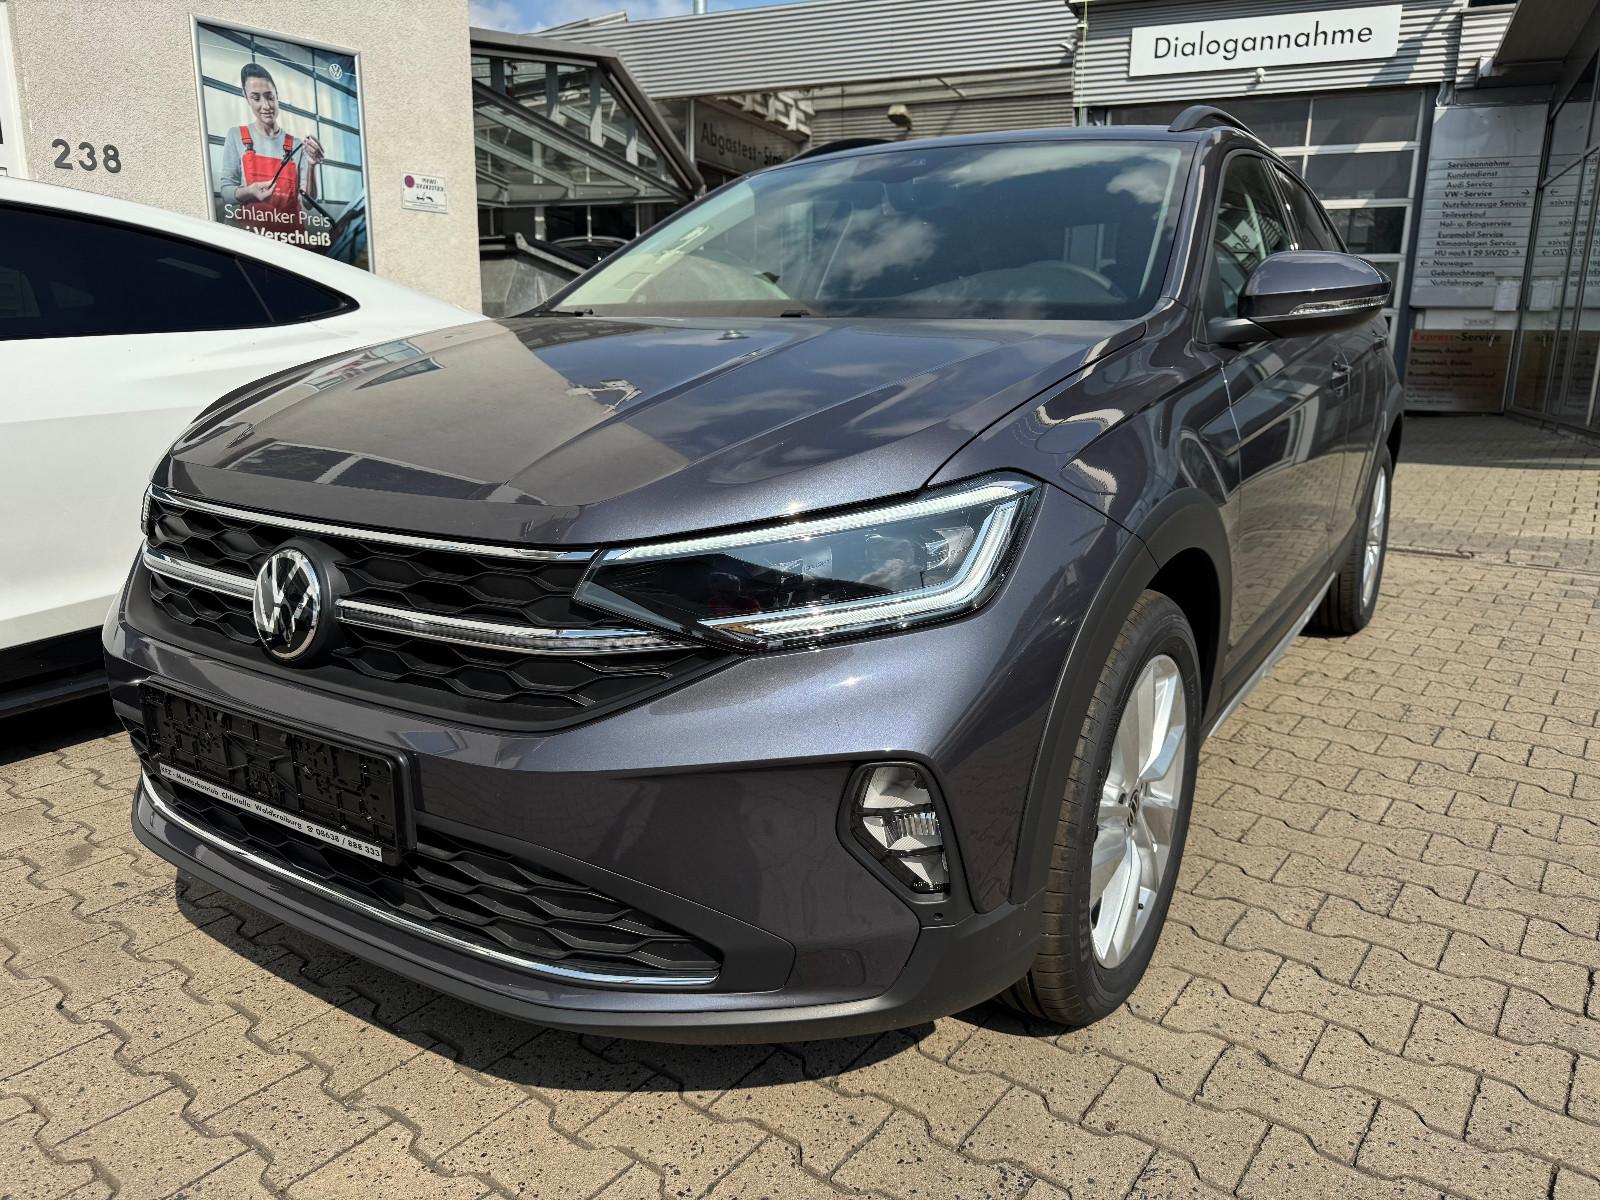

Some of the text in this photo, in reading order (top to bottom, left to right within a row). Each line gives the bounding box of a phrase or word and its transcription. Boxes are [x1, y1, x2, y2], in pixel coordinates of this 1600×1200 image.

[1153, 20, 1374, 61] Dialogannahme
[51, 138, 122, 174] 238
[1447, 160, 1510, 169] Serviceannahme
[1447, 171, 1498, 179] Kundendienst
[1446, 181, 1464, 189] Audi
[1442, 201, 1498, 209] Nutzfahrzeuge
[224, 203, 331, 228] Schlanker Preis
[1433, 259, 1474, 268] Neuwagen
[315, 828, 340, 843] 08638
[347, 840, 363, 851] 888
[364, 846, 380, 857] 333
